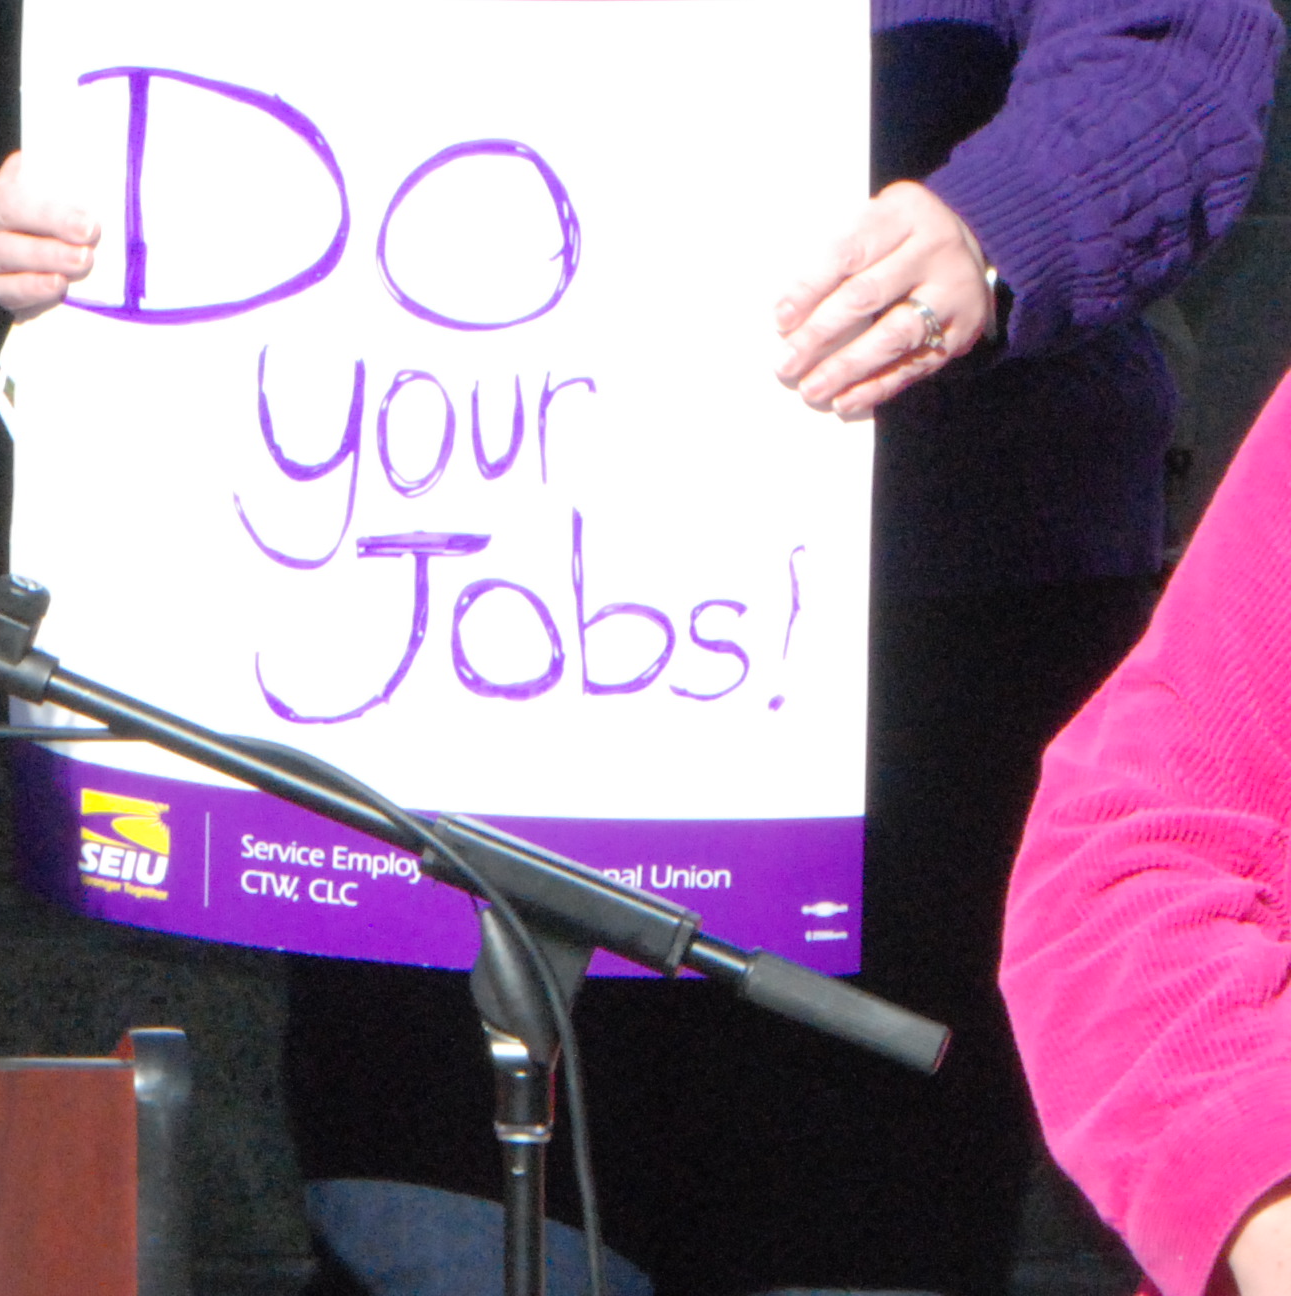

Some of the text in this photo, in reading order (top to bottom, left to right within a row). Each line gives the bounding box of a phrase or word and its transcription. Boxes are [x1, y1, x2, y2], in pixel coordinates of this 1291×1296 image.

[255, 507, 806, 724] Jobs!
[78, 841, 169, 885] SEIU
[240, 834, 326, 868] Service
[649, 864, 732, 890] Union
[240, 870, 359, 907] CTW, CLC
